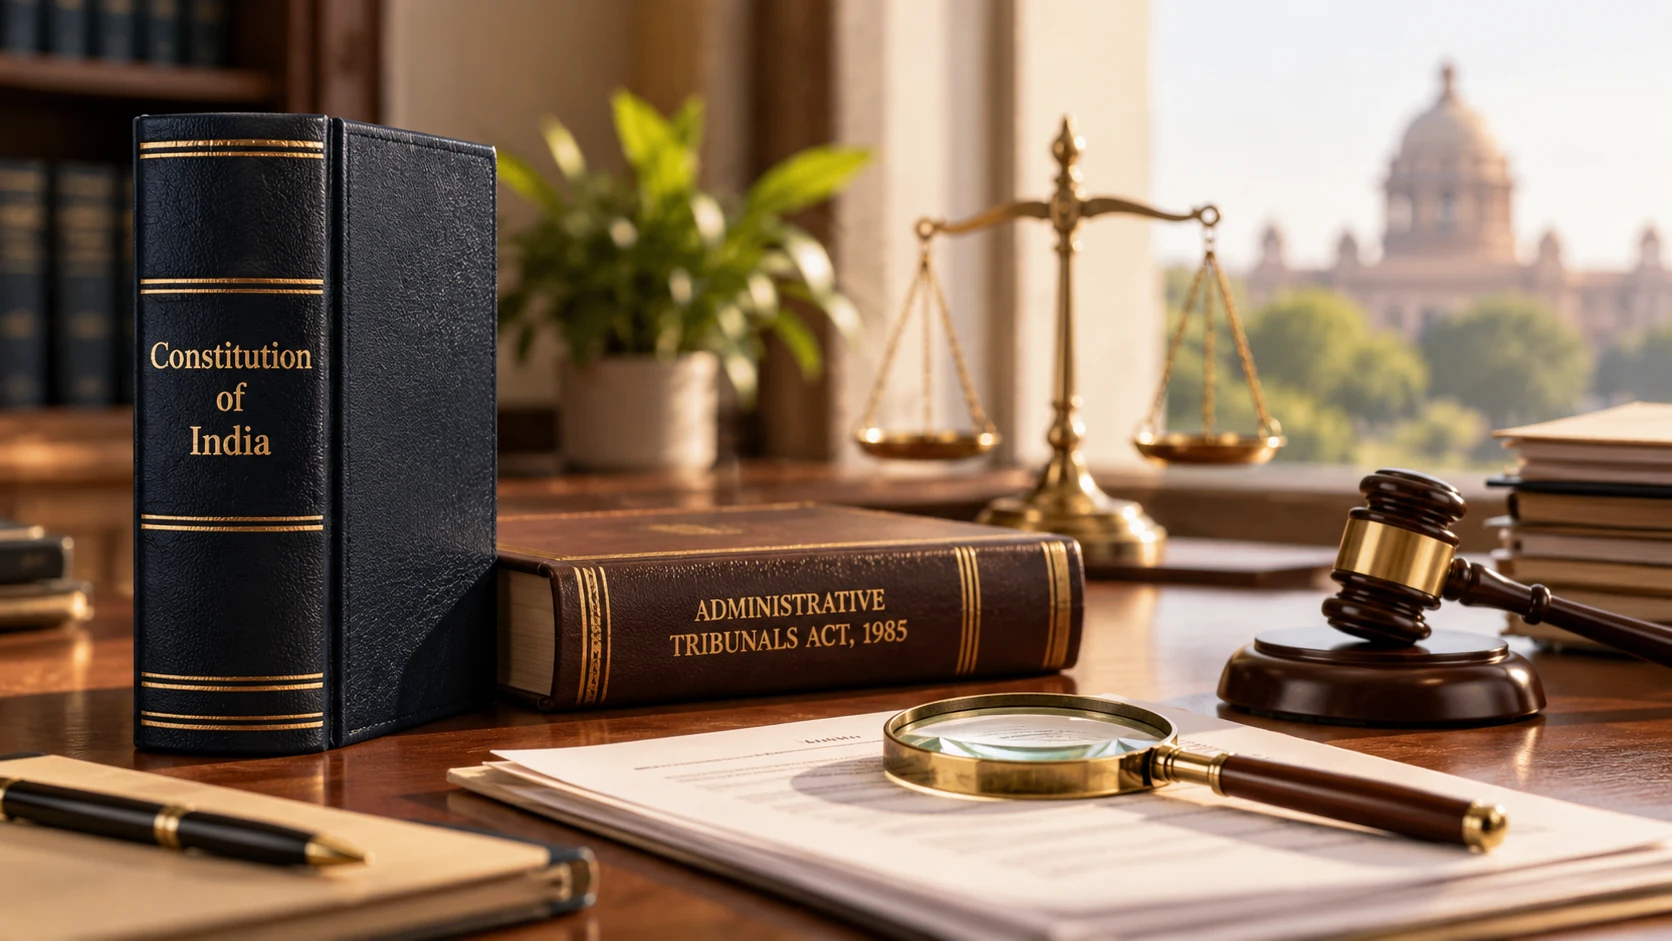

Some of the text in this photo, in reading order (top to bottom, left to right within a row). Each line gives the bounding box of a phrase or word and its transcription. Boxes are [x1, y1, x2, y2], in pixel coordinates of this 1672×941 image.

[150, 341, 313, 370] Constitution
[216, 381, 248, 412] of
[189, 424, 272, 456] India
[694, 588, 886, 622] ADMINISTRATIVE
[669, 618, 908, 657] TRIBUNALS ACT, 1985
